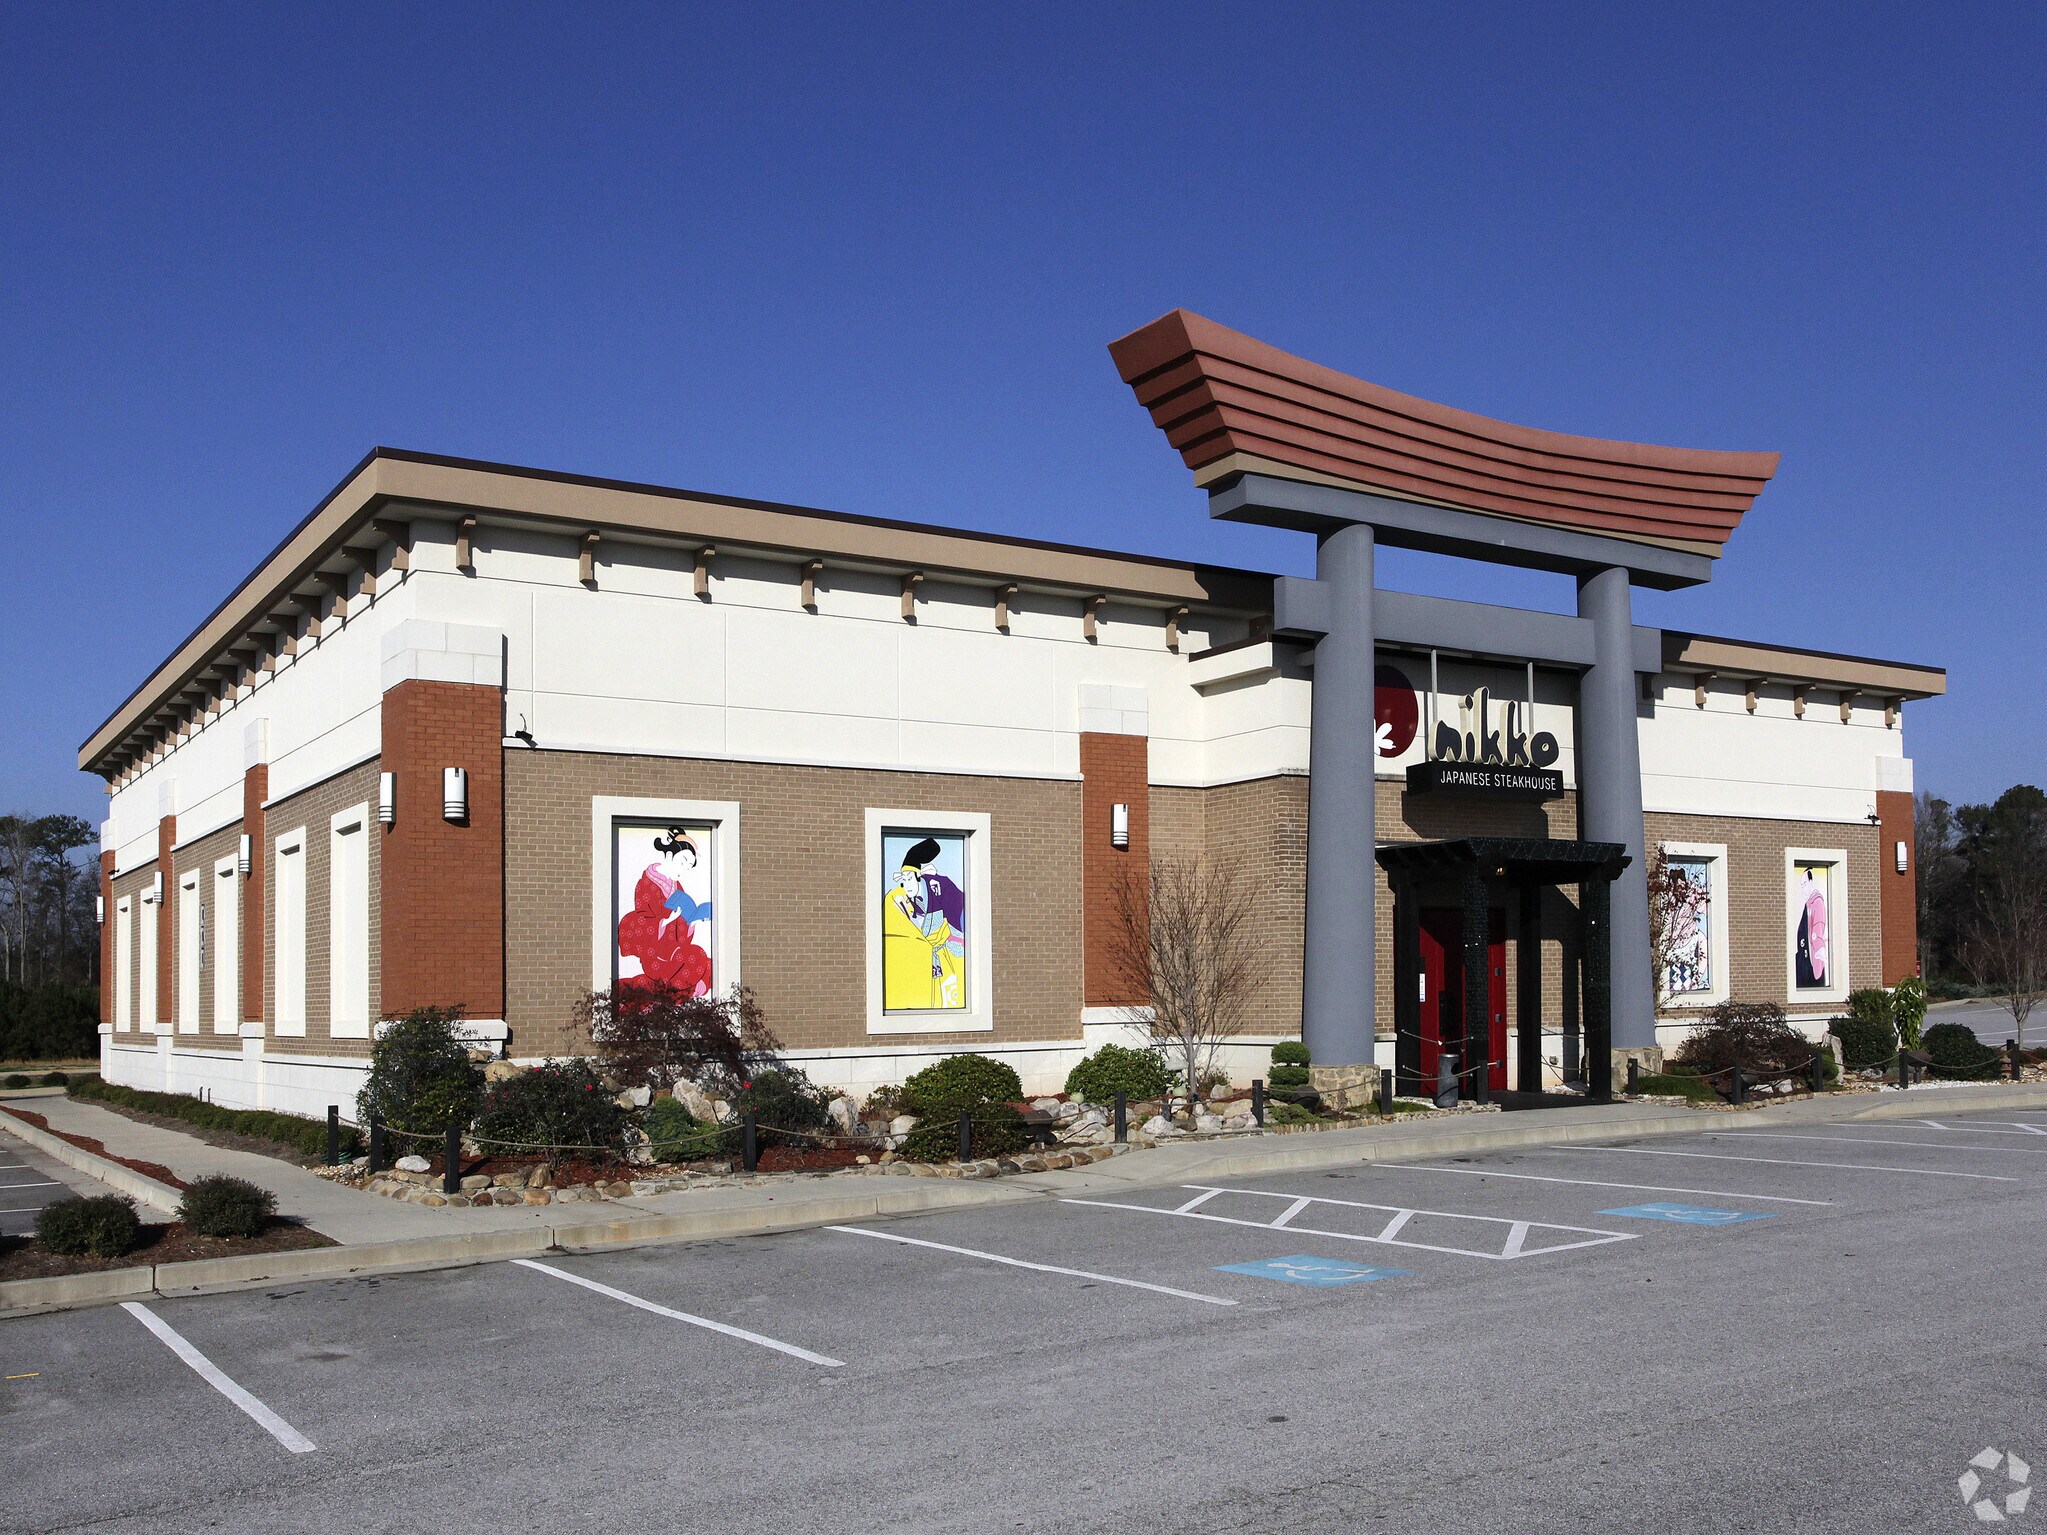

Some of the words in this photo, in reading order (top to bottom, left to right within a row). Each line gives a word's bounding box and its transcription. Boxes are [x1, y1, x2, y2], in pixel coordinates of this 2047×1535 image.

[1429, 686, 1560, 767] nikko
[1440, 770, 1491, 787] JAPANESE
[1494, 773, 1557, 791] STEAKHOUSE
